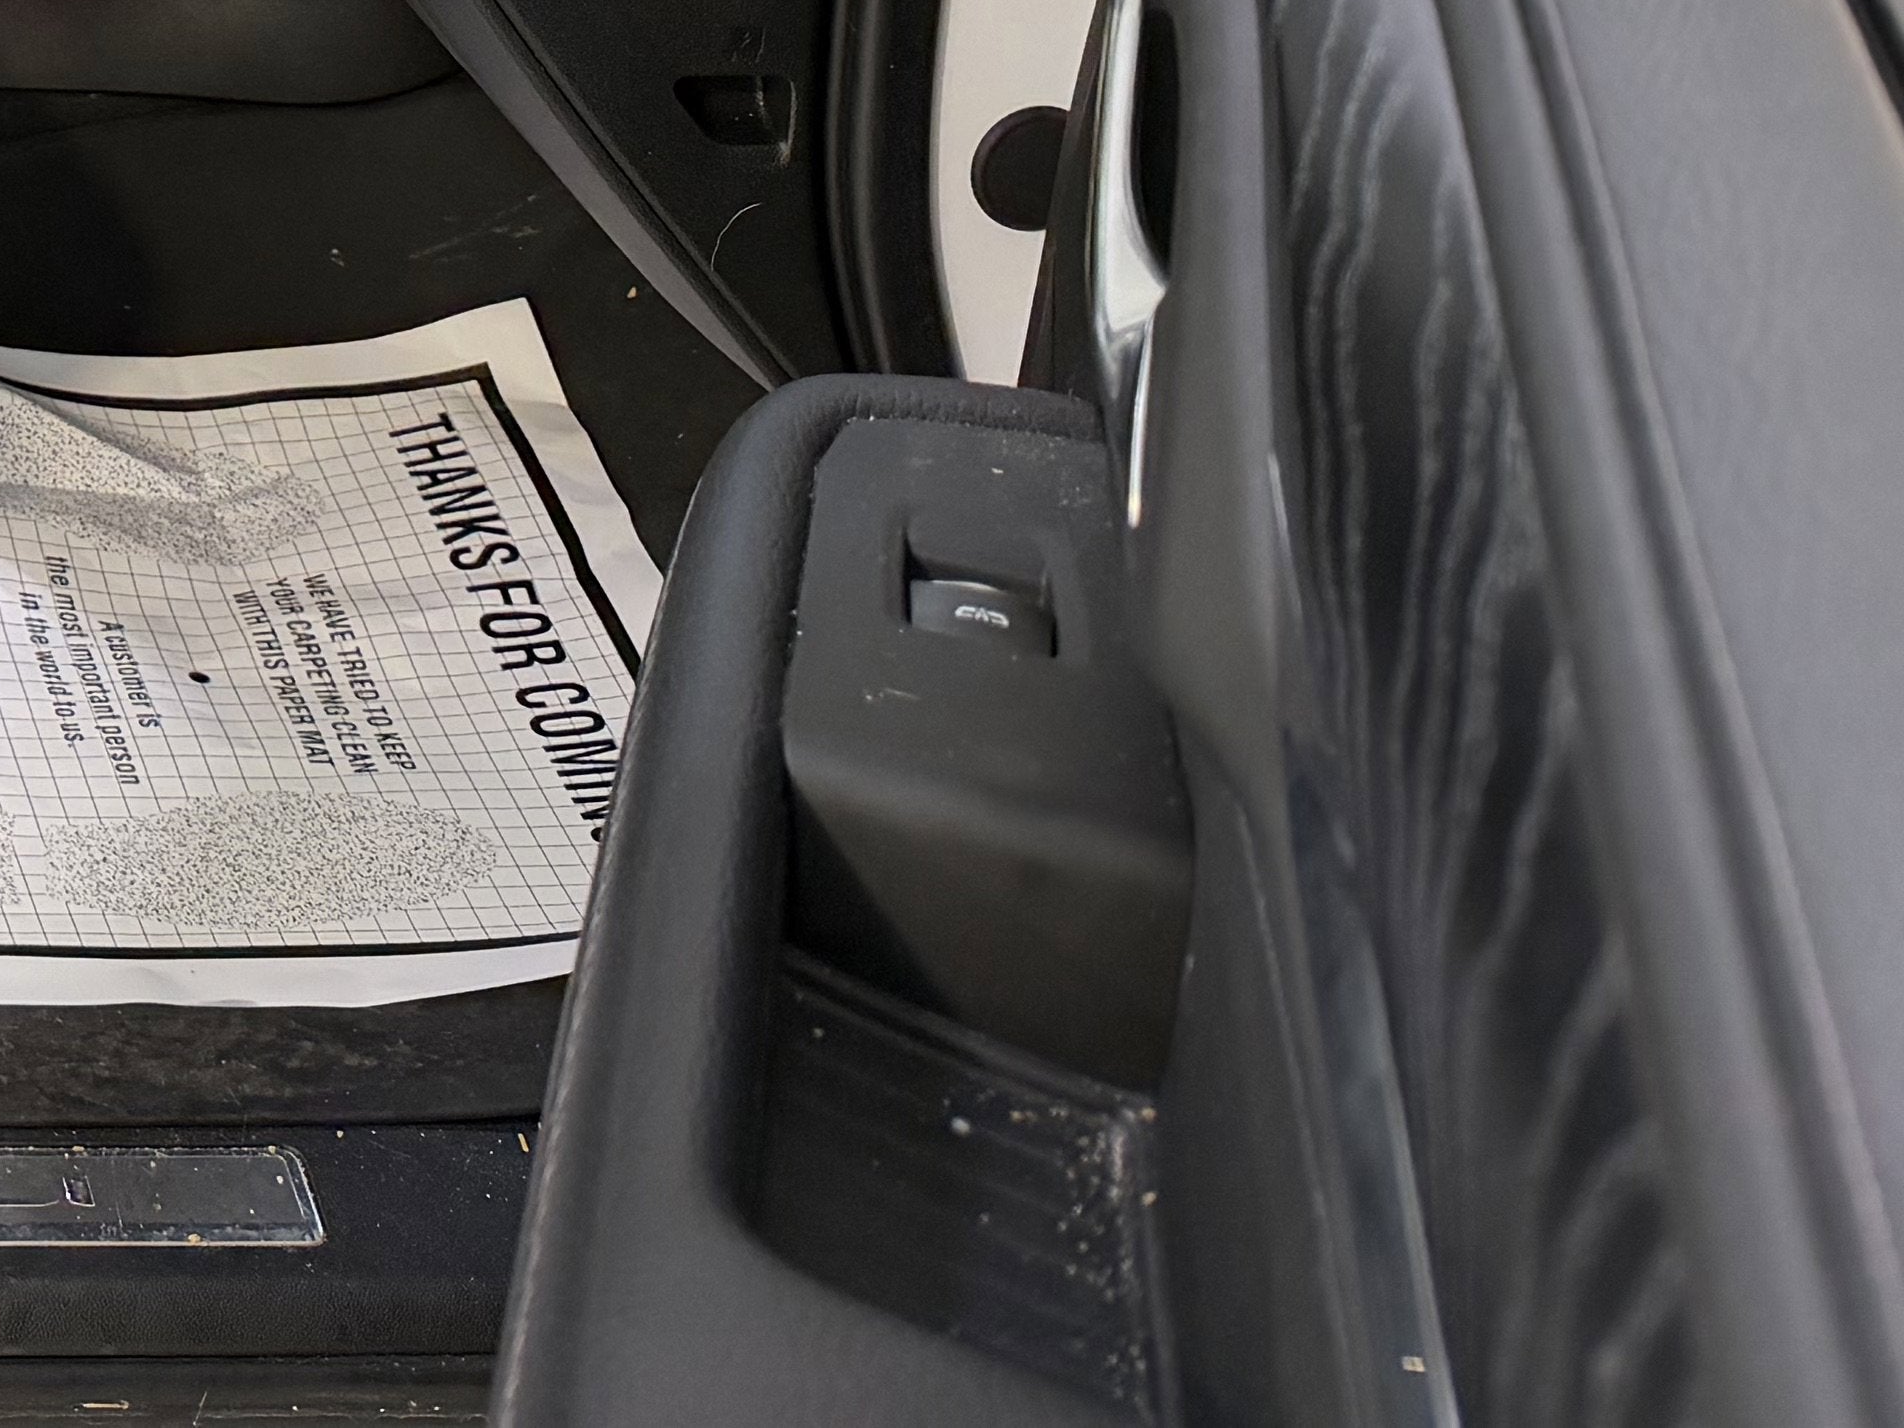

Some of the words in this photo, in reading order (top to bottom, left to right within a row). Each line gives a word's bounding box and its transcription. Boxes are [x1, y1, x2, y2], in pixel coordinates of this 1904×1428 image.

[389, 412, 519, 571] THANKS
[44, 555, 71, 587] the
[303, 573, 333, 599] WE
[18, 591, 41, 611] in
[53, 593, 87, 639] most
[233, 590, 272, 626] WITH
[315, 599, 356, 643] HAVE
[25, 615, 51, 646] the
[97, 619, 124, 632] A
[465, 580, 567, 671] FOR
[252, 628, 289, 671] THIS
[34, 650, 73, 696] world
[69, 643, 122, 729] important
[104, 635, 152, 710] customer
[266, 577, 304, 616] YOUR
[285, 619, 349, 717] CARPETING
[330, 718, 379, 774] CLEAN
[337, 646, 380, 702] TRIED
[53, 700, 76, 719] to
[138, 712, 162, 729] is
[268, 674, 316, 726] PAPER
[361, 706, 392, 728] TO
[97, 725, 140, 785] person
[296, 727, 335, 768] MAT
[374, 732, 417, 772] KEEP
[515, 682, 618, 843] COMI
